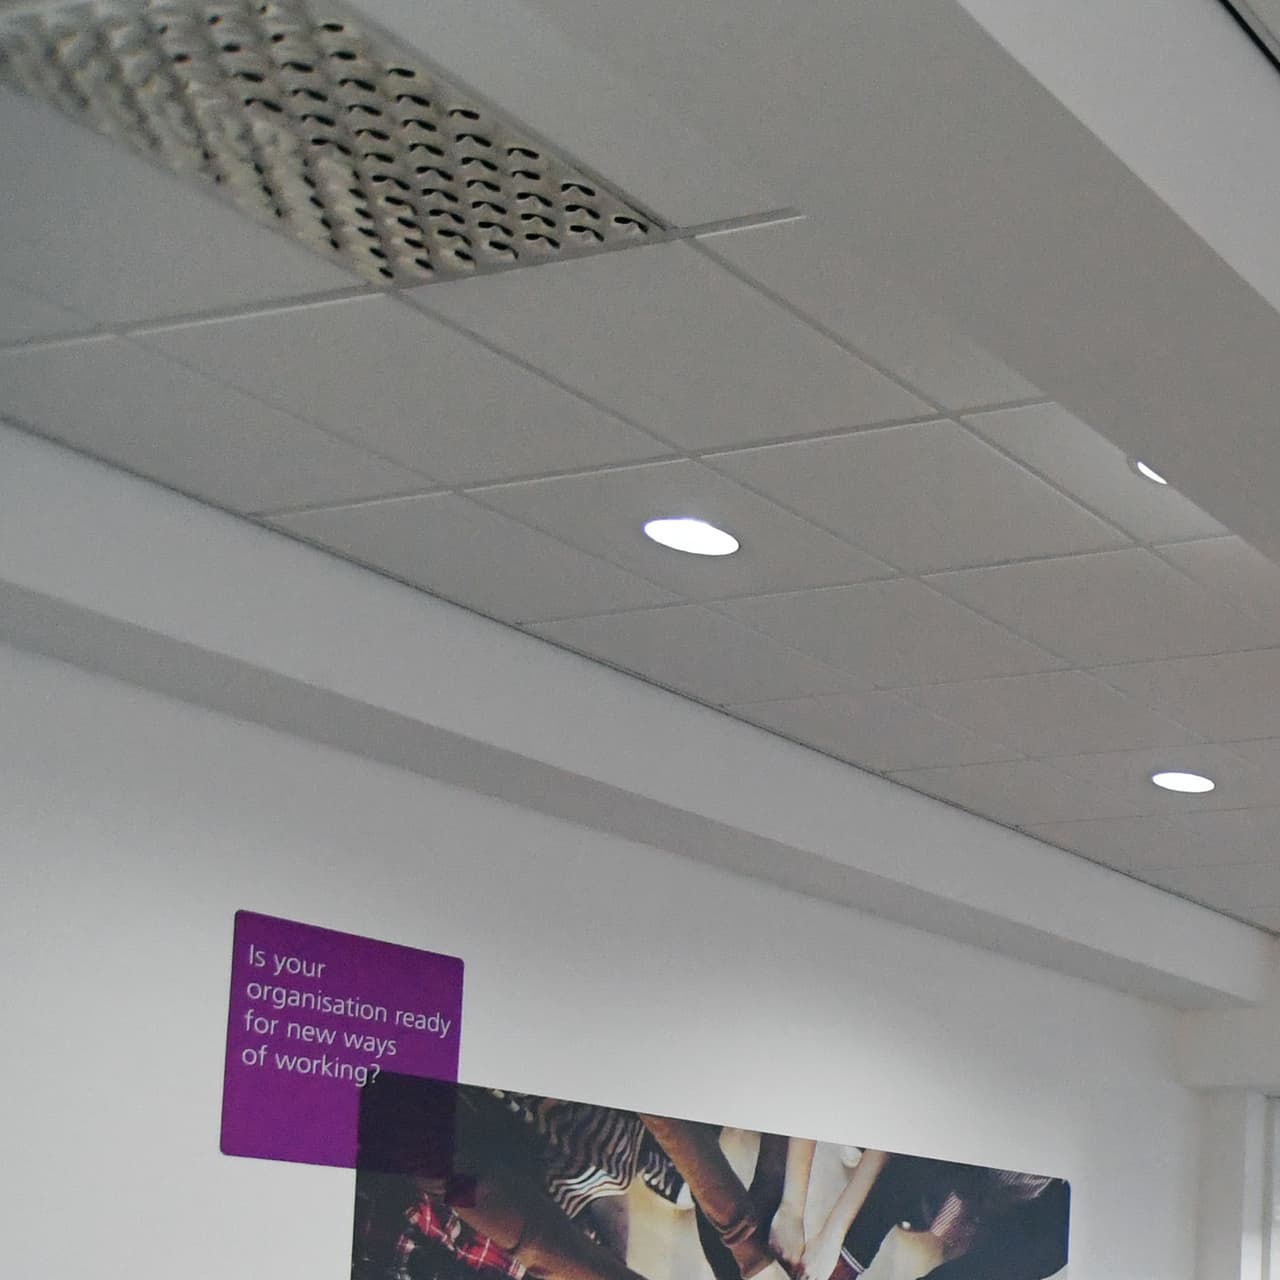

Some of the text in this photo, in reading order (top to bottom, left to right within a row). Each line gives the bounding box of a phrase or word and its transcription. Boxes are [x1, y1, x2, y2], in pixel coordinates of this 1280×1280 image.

[249, 944, 326, 978] Is your
[246, 982, 451, 1038] organisation ready
[244, 1009, 397, 1058] for new ways
[241, 1045, 381, 1088] of working?
